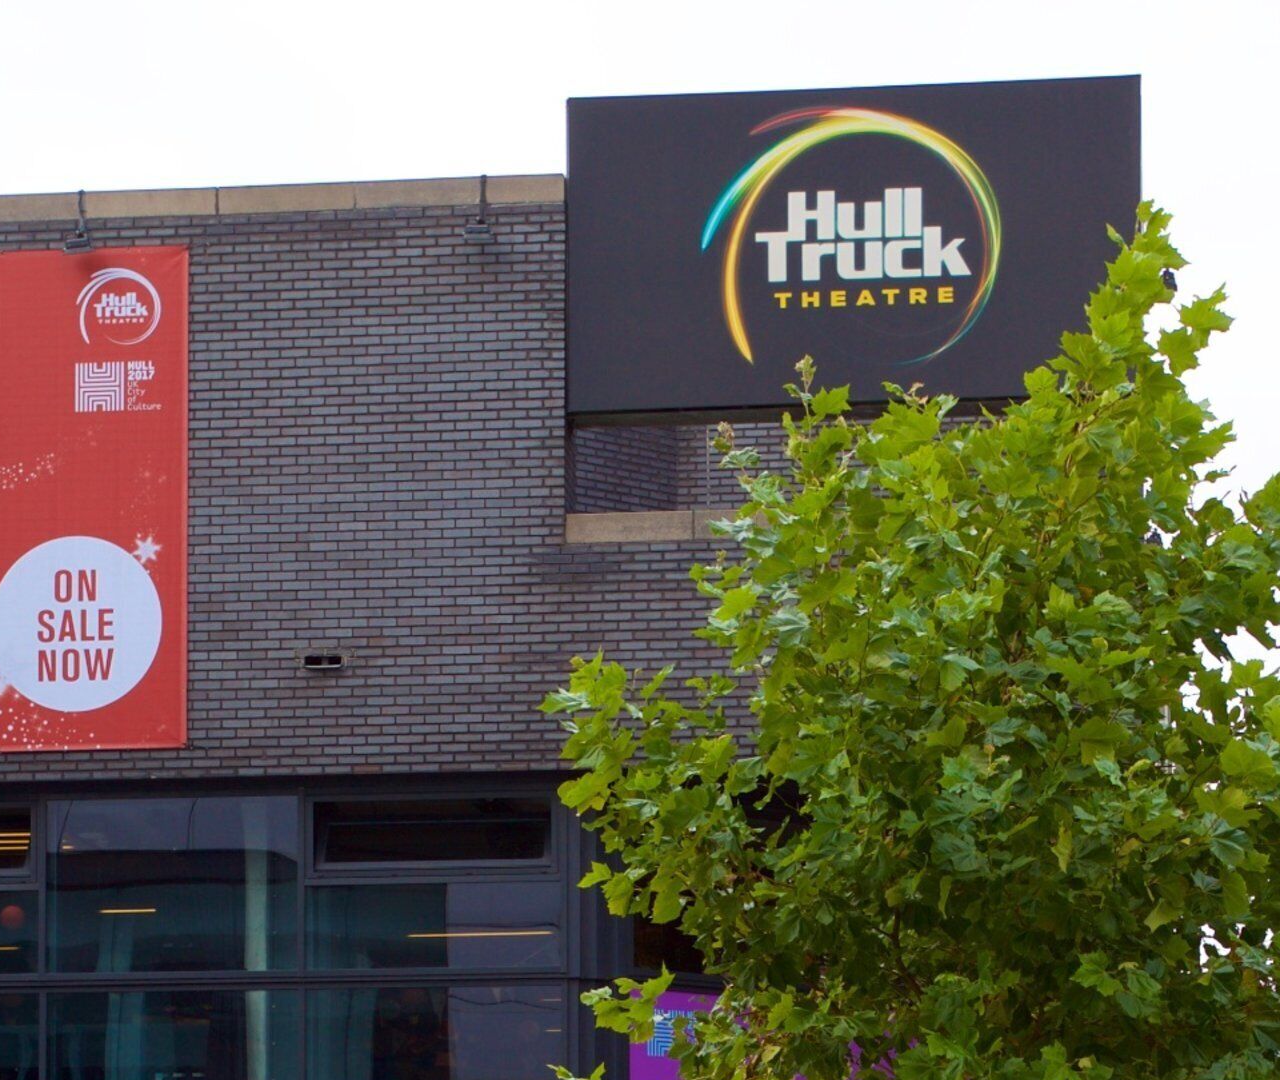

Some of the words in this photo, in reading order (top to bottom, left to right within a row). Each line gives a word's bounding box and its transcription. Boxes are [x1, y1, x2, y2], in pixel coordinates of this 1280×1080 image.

[787, 187, 922, 241] Hull
[755, 226, 972, 282] Truck
[101, 292, 137, 307] Hull
[774, 287, 954, 308] THEATRE
[94, 303, 148, 317] Truck
[128, 361, 155, 370] HULL
[128, 371, 155, 380] 2017
[128, 388, 145, 397] City
[128, 403, 162, 411] Culture
[54, 569, 96, 603] ON
[37, 609, 114, 643] SALE
[37, 649, 114, 682] NOW
